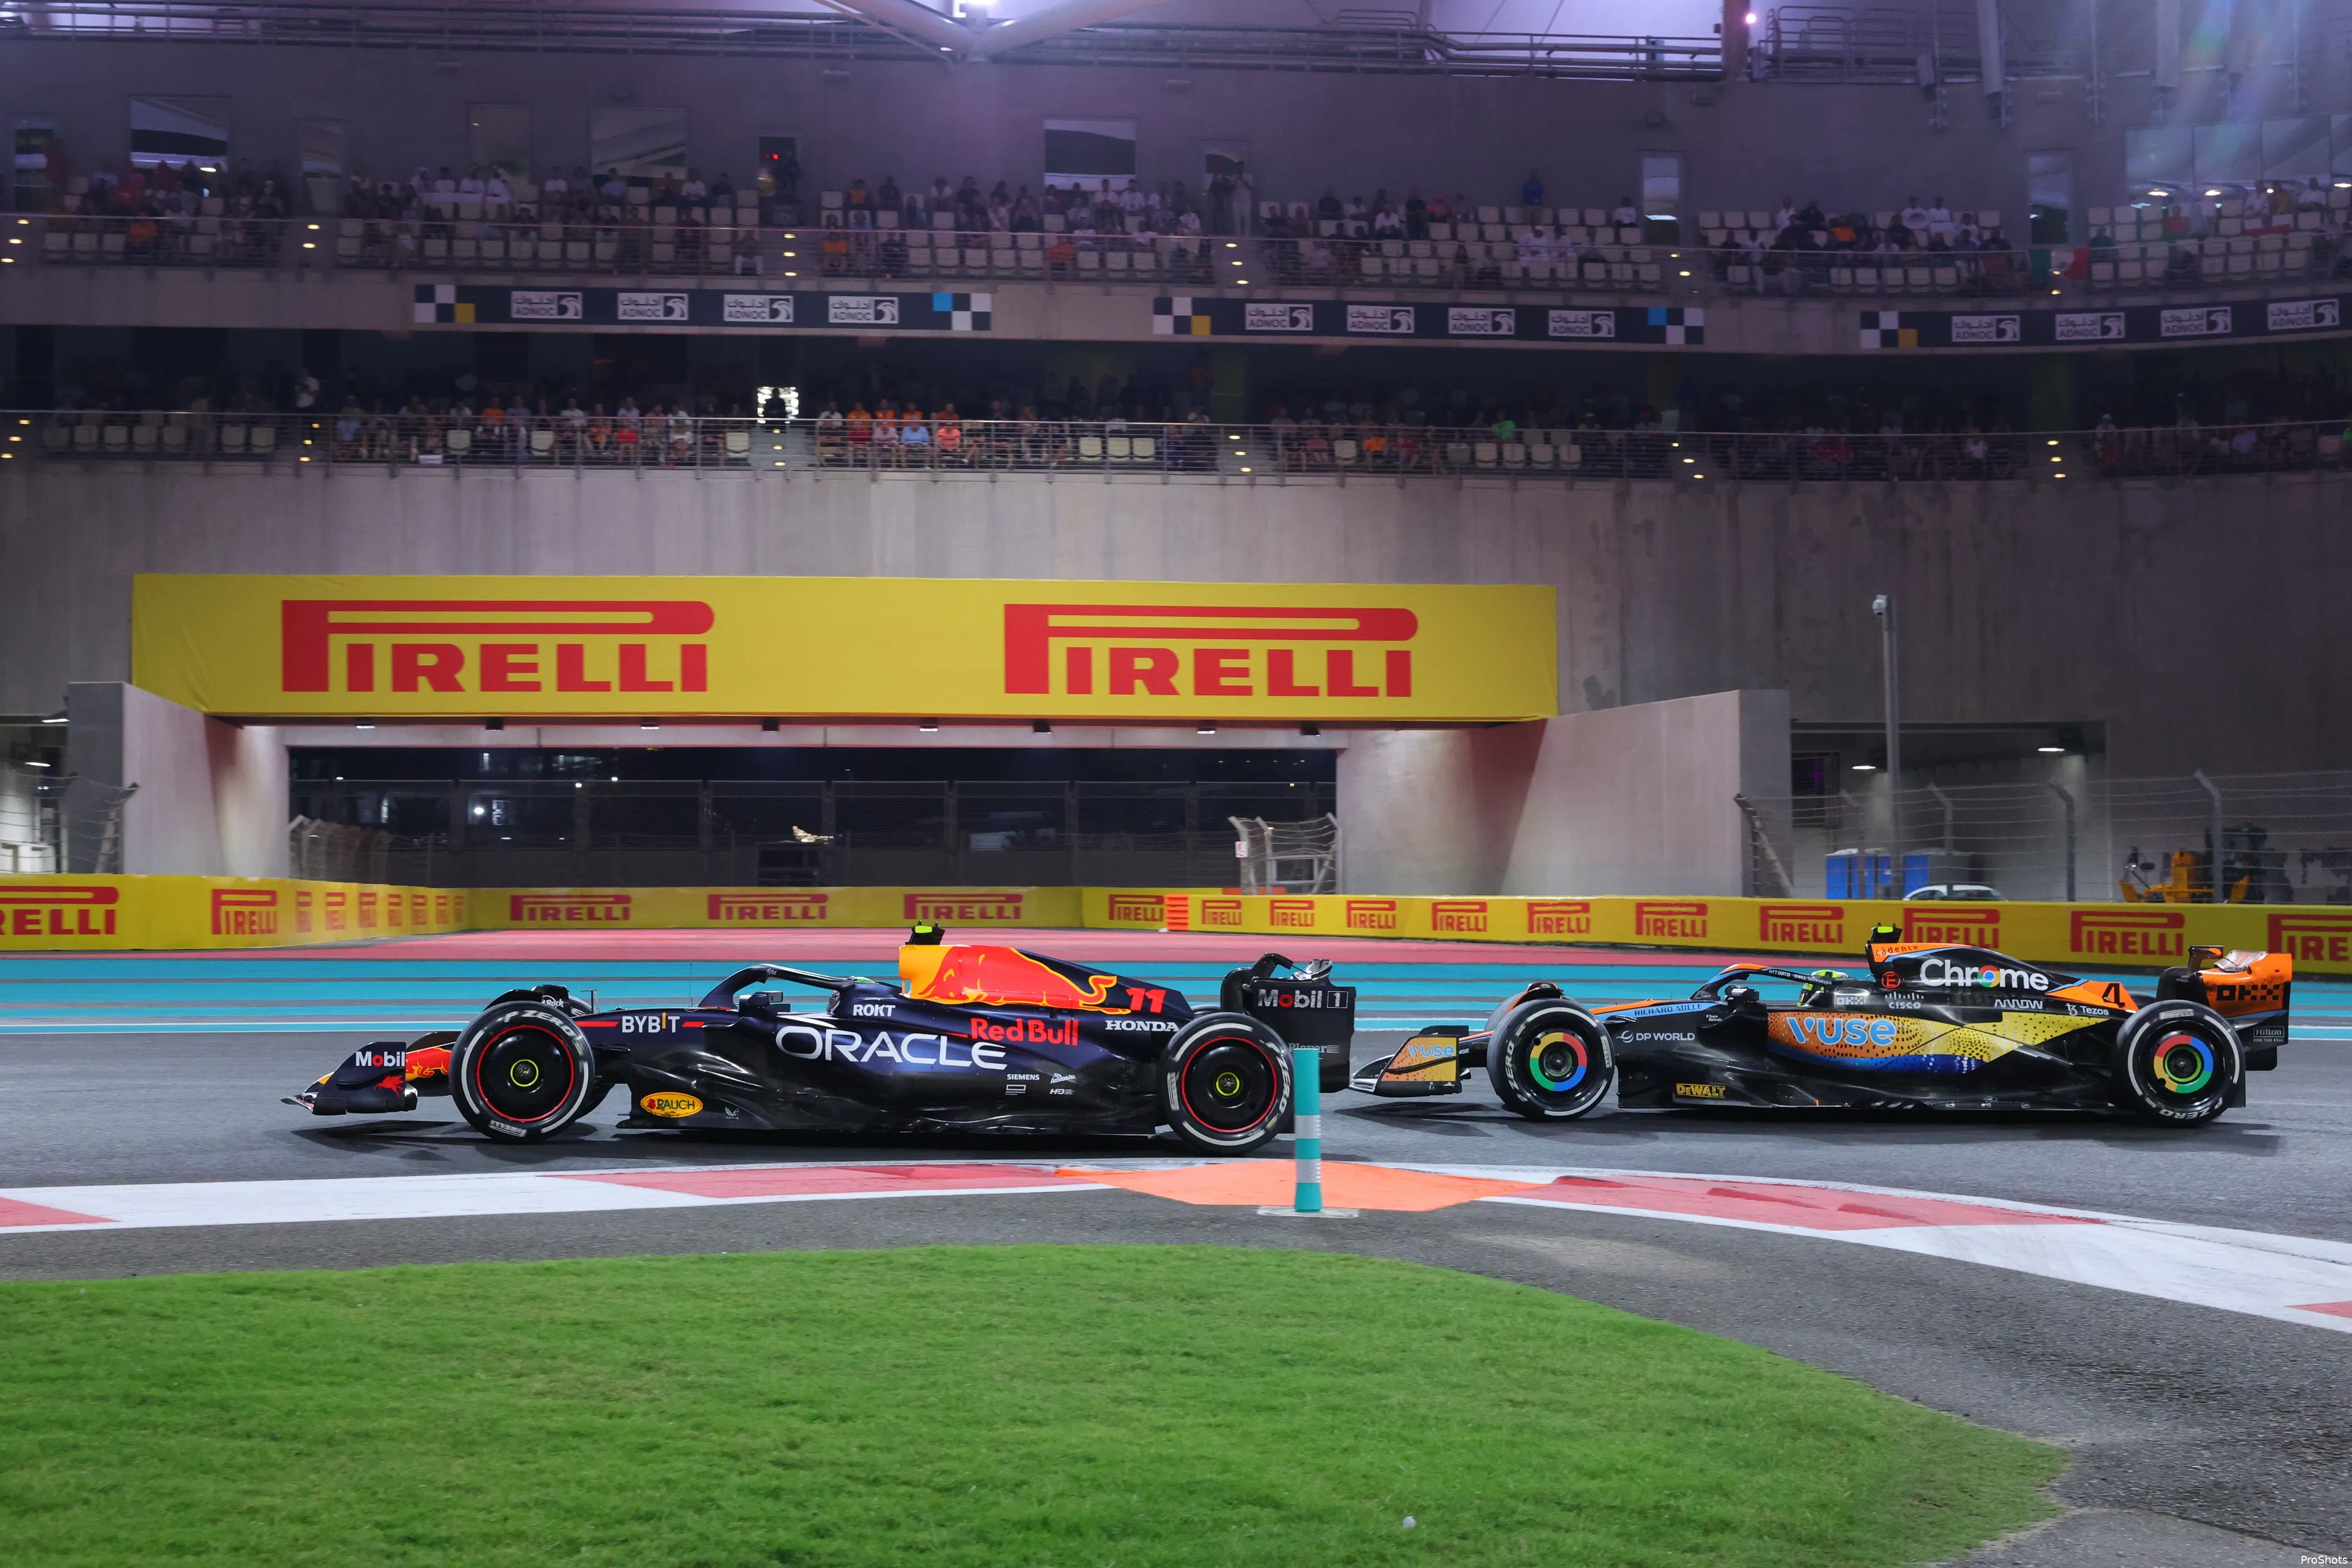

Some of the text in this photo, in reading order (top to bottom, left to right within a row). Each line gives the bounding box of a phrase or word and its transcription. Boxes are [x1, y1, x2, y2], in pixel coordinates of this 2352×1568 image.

[514, 307, 555, 316] ADNOC
[621, 309, 661, 317] ADNOC
[727, 311, 766, 319] ADNOC
[832, 312, 872, 320] ADNOC
[1250, 319, 1287, 328] ADNOC
[2271, 317, 2313, 327] ADNOC
[1350, 321, 1388, 330] ADNOC
[1551, 326, 1590, 334] ADNOC
[2059, 329, 2098, 337] ADNOC
[2164, 323, 2204, 333] ADNOC
[282, 600, 715, 692] PIRELLI
[1004, 603, 1418, 697] PIRELLI
[211, 889, 277, 935] PIRELLI
[510, 894, 632, 921] PIRELLI
[707, 894, 829, 920] PIRELLI
[903, 894, 1023, 920] PIRELLI
[1109, 894, 1164, 921] PIRELLI
[1202, 900, 1242, 925] PIRELLI
[1270, 899, 1314, 927] PIRELLI
[1346, 900, 1396, 929] PIRELLI
[1432, 902, 1487, 932] PIRELLI
[1528, 902, 1591, 933] PIRELLI
[1635, 903, 1708, 938] PIRELLI
[1760, 905, 1844, 943] PIRELLI
[1904, 908, 2000, 948] PIRELLI
[2070, 911, 2185, 957] PIRELLI
[2267, 914, 2352, 961] PIRE
[1807, 976, 1832, 985] Technologies
[1920, 959, 2049, 991] Chrome
[546, 999, 564, 1008] Rock
[1126, 987, 1166, 1013] 11
[1258, 989, 1322, 1008] Mobil
[2102, 983, 2125, 1008] 4
[2217, 985, 2280, 1001] OKX
[622, 1012, 680, 1034] BYBIT
[853, 1004, 895, 1017] ROKT
[1634, 1006, 1673, 1016] RICHARD
[2080, 1006, 2109, 1016] Tezos
[521, 1010, 576, 1037] ZERO
[971, 1018, 1079, 1046] Red Bull
[1105, 1020, 1180, 1031] HONDA
[355, 1051, 405, 1068] Mobil
[776, 1026, 1008, 1070] ORACLE
[1506, 1040, 1519, 1090] ZERO
[657, 1099, 695, 1109] RAUCH
[2158, 1107, 2211, 1120] ZERO
